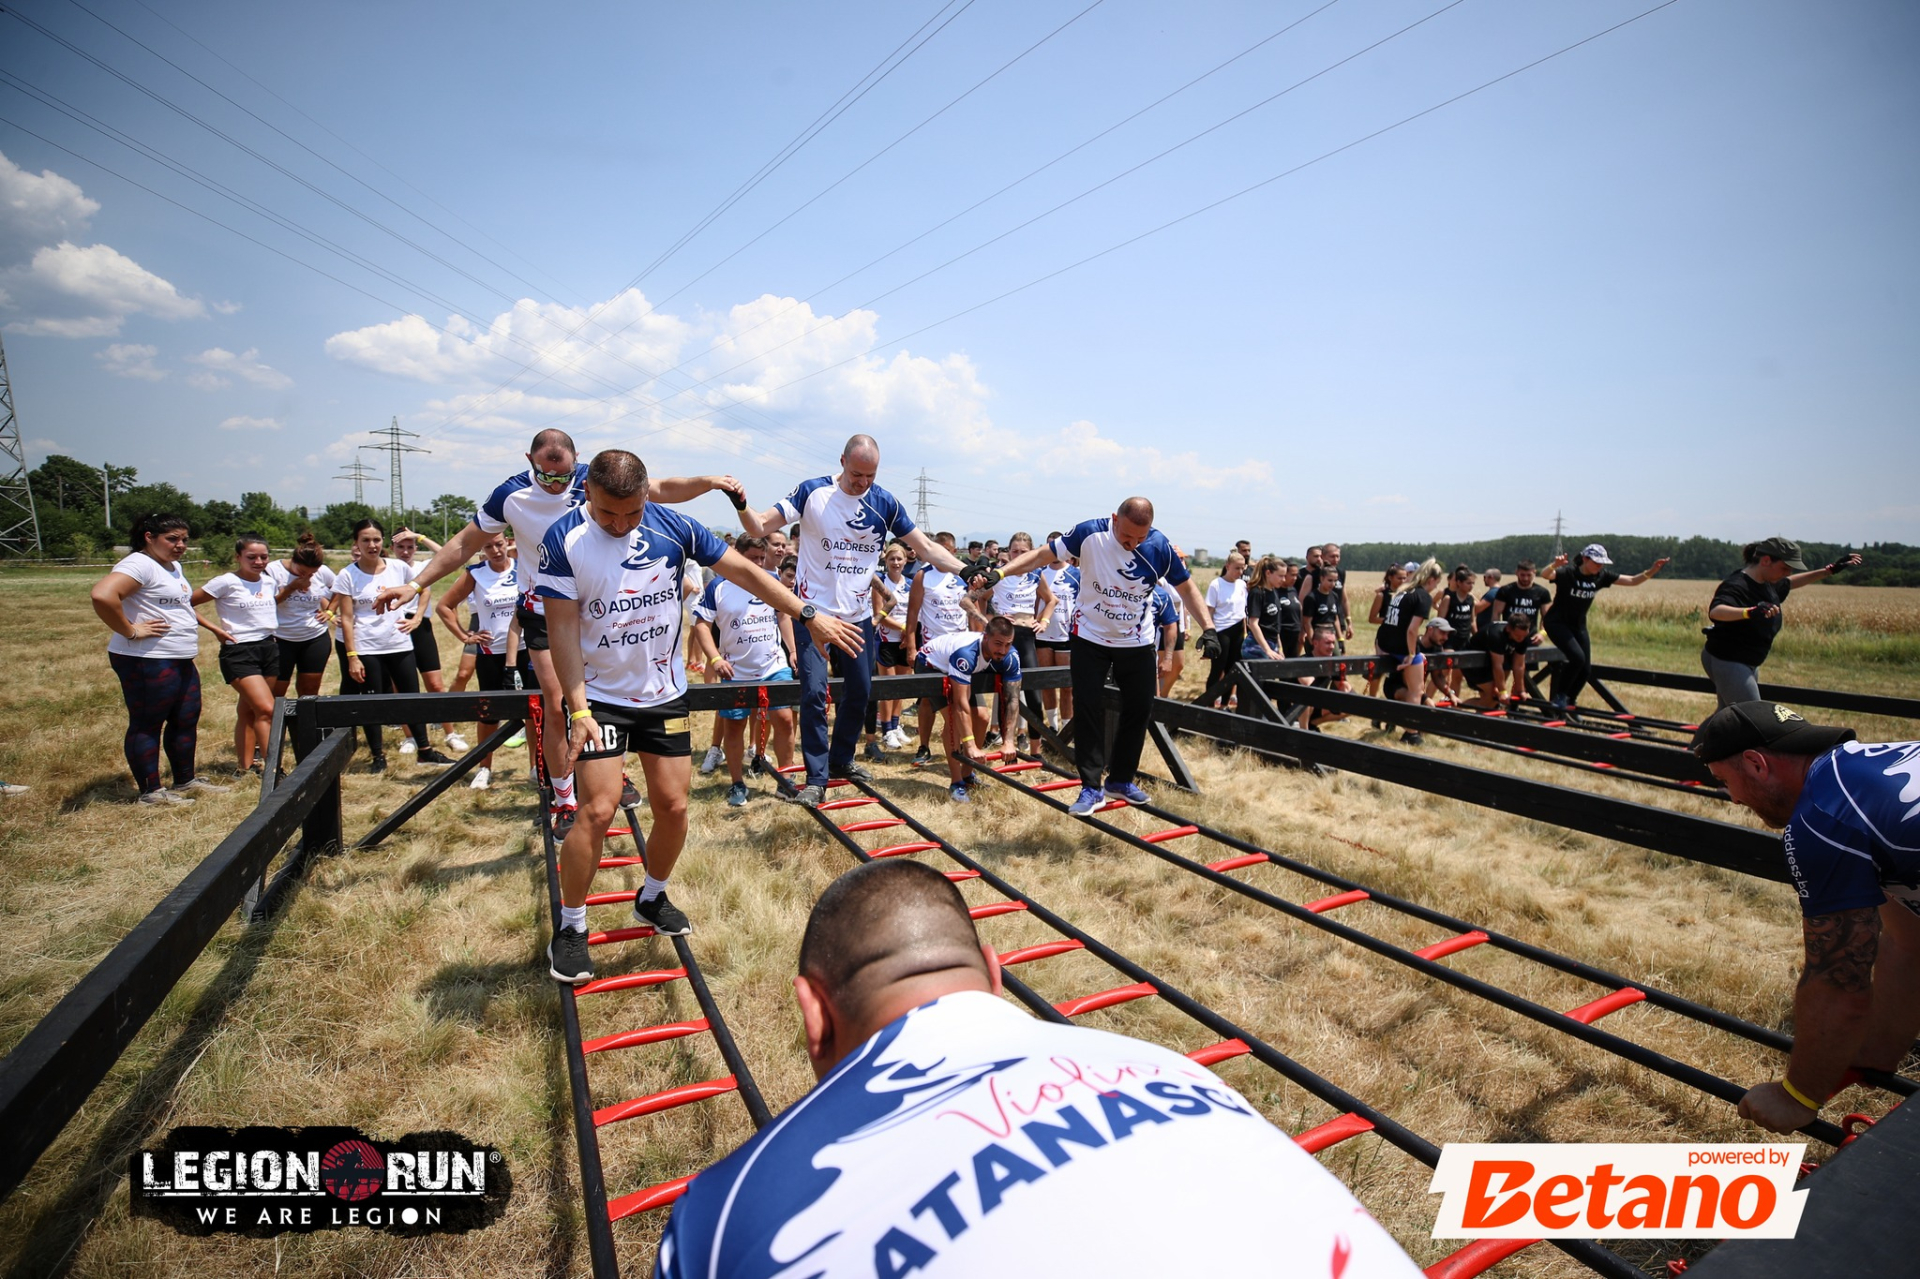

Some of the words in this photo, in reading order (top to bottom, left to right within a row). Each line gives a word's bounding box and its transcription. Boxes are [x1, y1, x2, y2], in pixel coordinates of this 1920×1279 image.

[832, 540, 876, 553] ADDRESS
[824, 561, 869, 575] A-factor
[608, 588, 674, 614] ADDRESS
[1101, 588, 1143, 603] ADDRESS
[1520, 598, 1533, 606] AM
[239, 600, 276, 609] DISCOVE
[1093, 602, 1137, 621] A-factor
[490, 610, 515, 619] A-fac
[612, 616, 646, 629] Powered
[647, 614, 656, 623] by
[597, 623, 671, 648] A-factor
[736, 634, 774, 645] A-factor
[1783, 824, 1810, 898] address.bg
